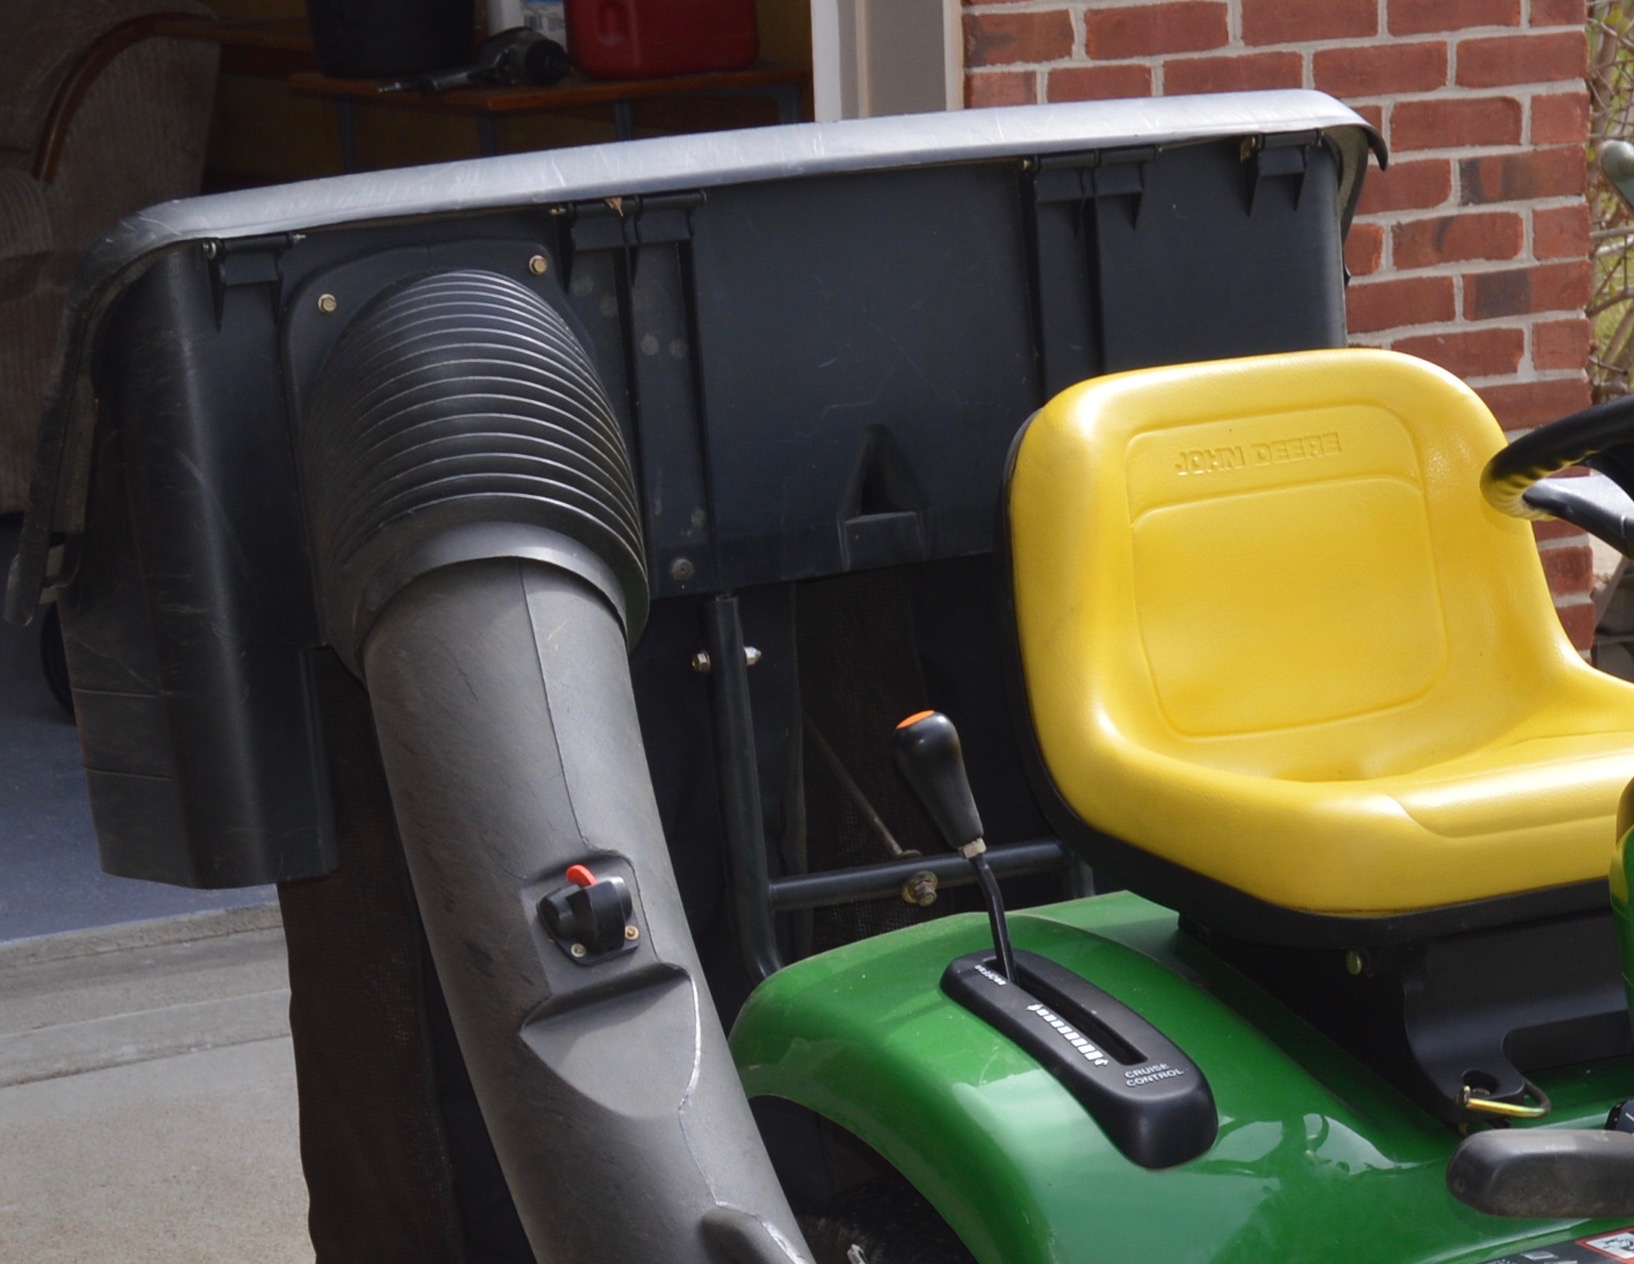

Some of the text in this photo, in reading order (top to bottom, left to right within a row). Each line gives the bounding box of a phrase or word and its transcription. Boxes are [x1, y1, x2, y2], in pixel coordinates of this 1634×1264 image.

[1175, 432, 1343, 476] JOHN DEERE
[1125, 1063, 1169, 1078] CRUISE
[1126, 1069, 1184, 1087] CONTROL
